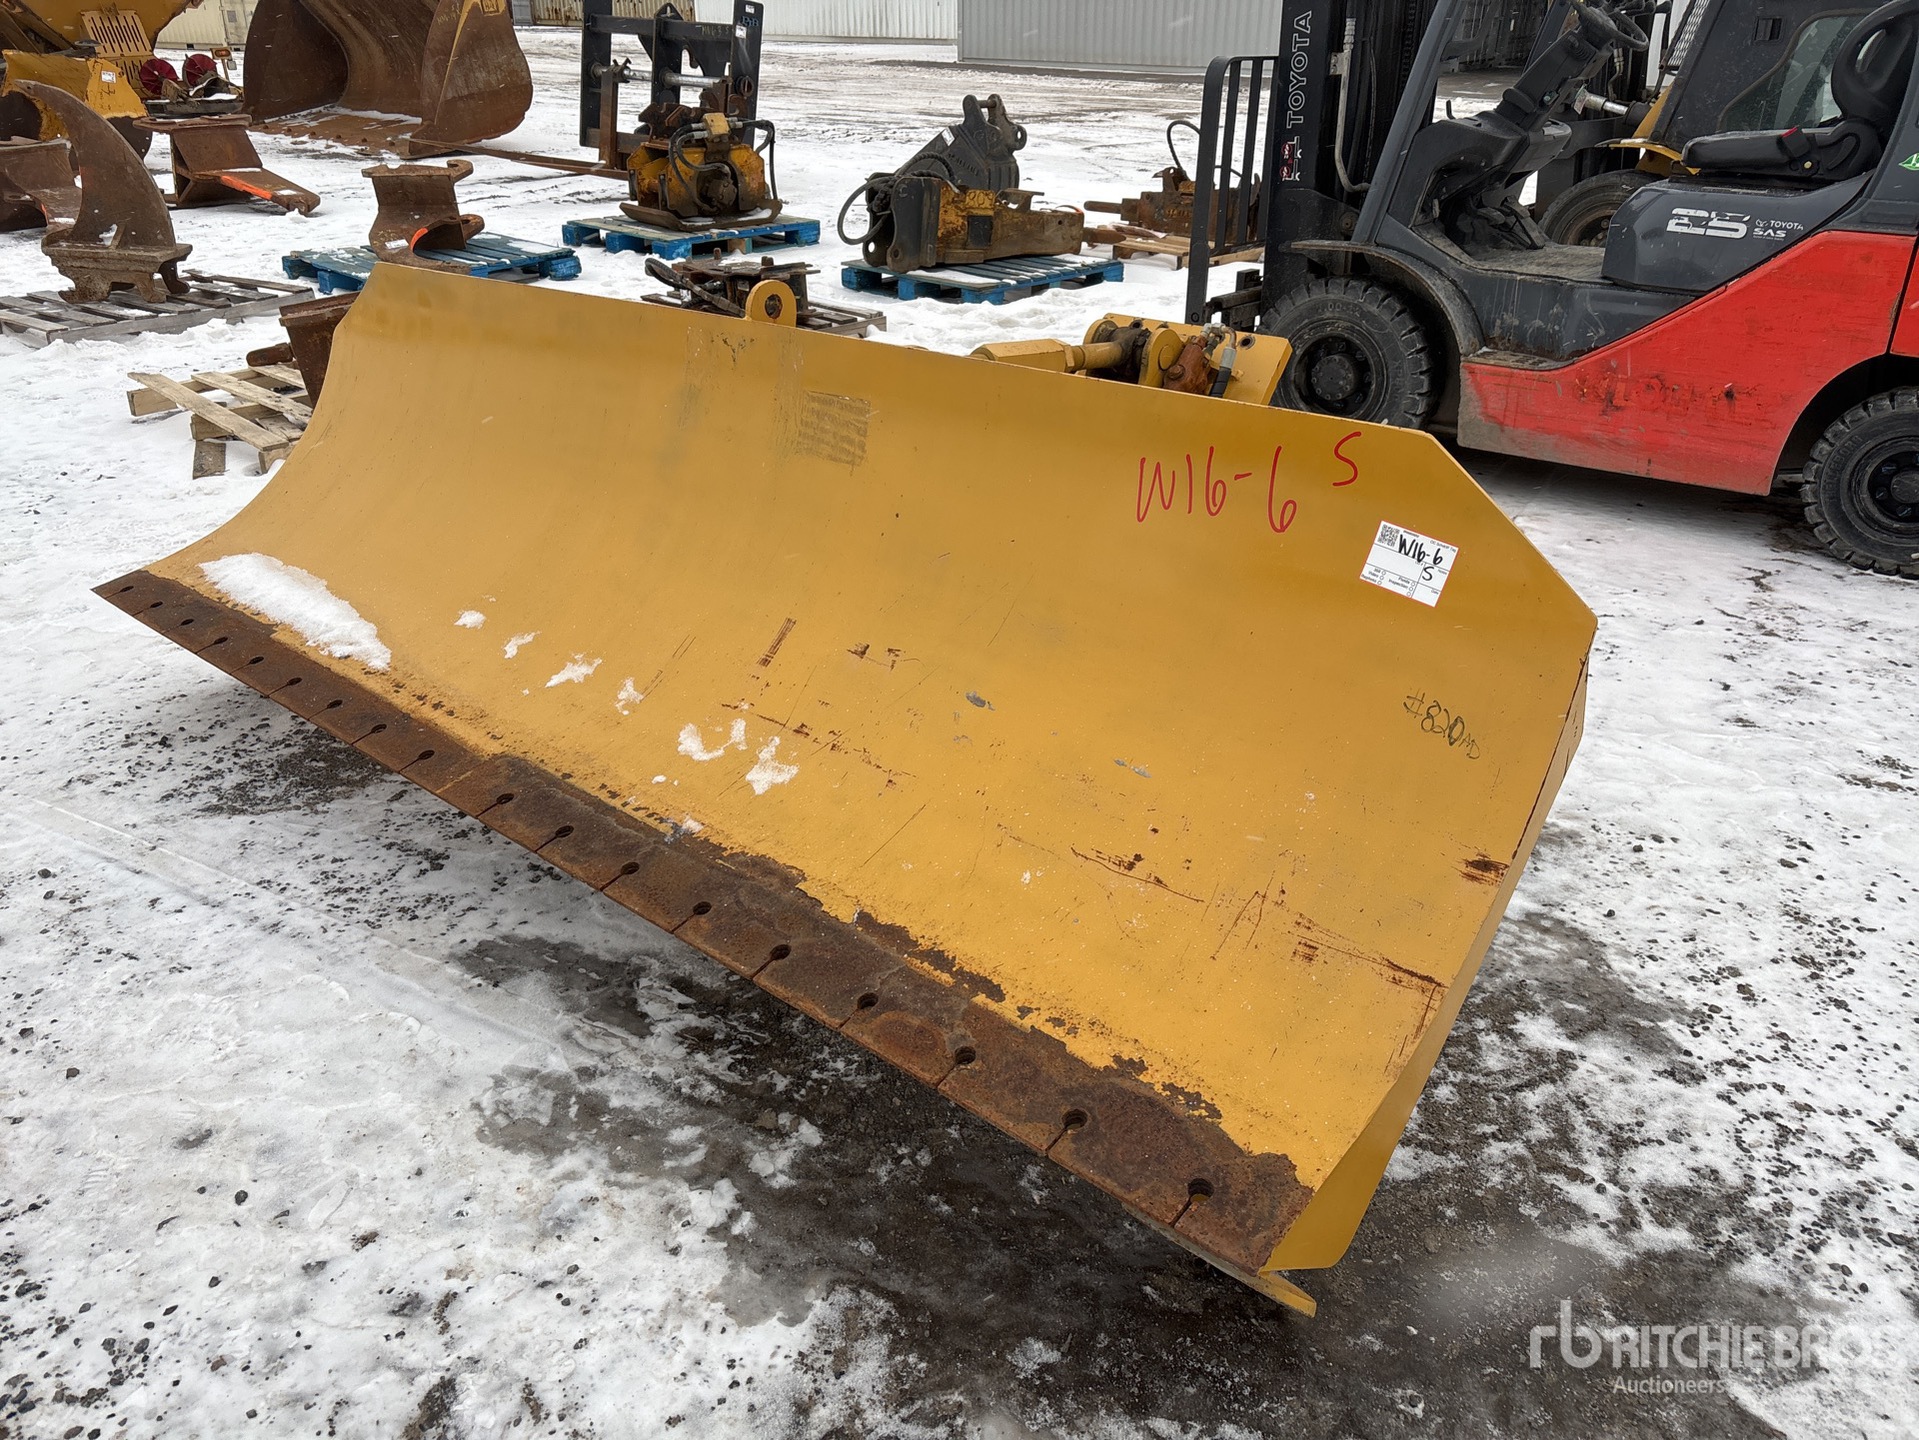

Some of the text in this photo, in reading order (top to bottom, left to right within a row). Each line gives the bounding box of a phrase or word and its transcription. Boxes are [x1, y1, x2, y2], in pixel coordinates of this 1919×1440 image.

[1286, 10, 1312, 129] TOYOTA
[1769, 220, 1804, 231] TOYOTA
[1752, 227, 1787, 238] SAS
